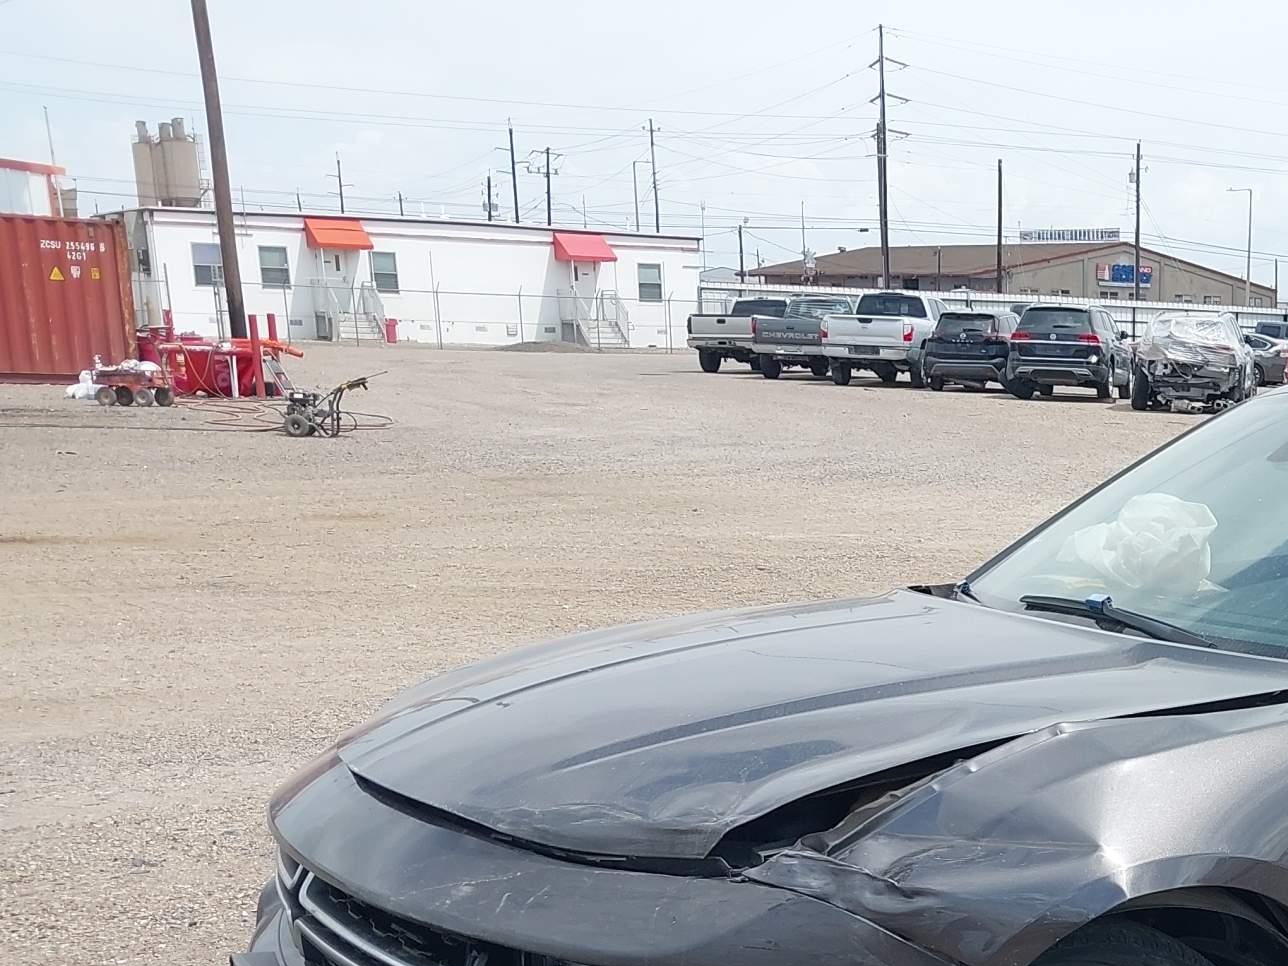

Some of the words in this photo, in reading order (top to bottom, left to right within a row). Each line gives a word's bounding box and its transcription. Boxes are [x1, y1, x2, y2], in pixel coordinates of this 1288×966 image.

[40, 239, 61, 249] ZCSU
[66, 252, 86, 261] 42G1
[762, 331, 819, 340] CHEVROLET
